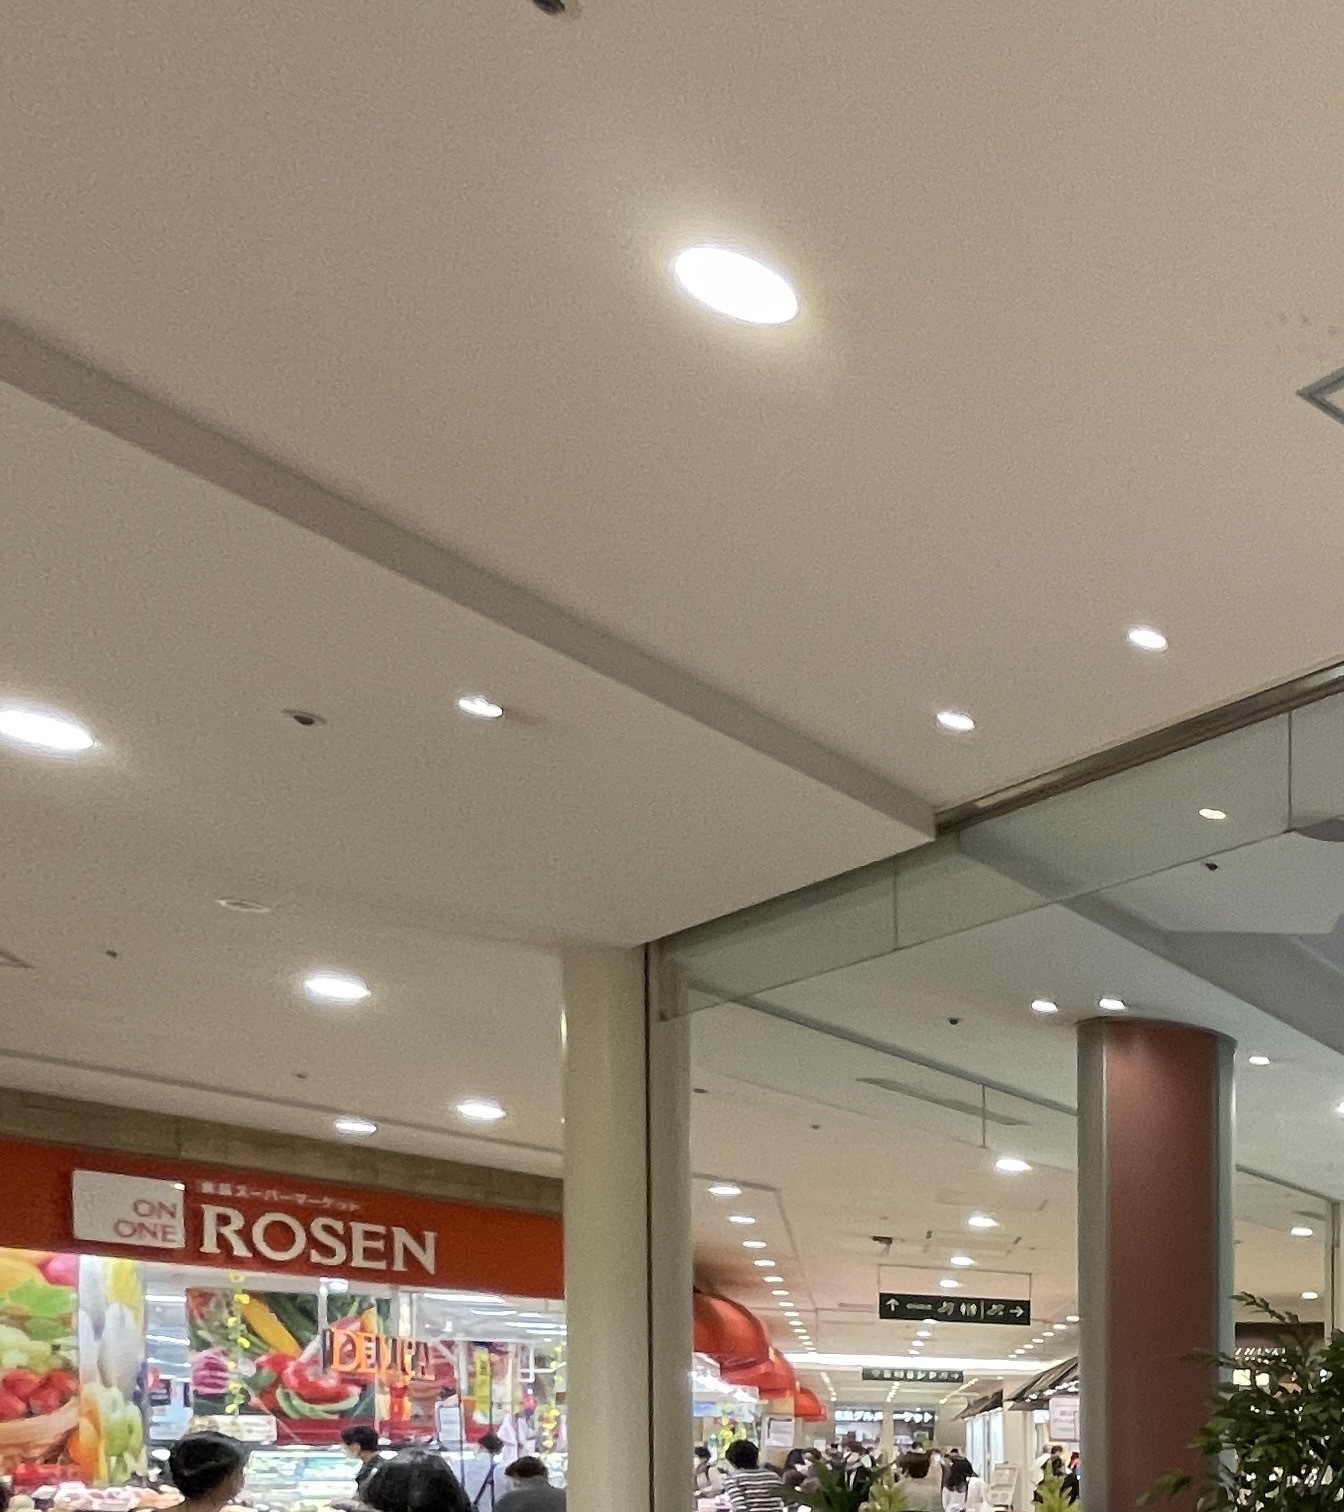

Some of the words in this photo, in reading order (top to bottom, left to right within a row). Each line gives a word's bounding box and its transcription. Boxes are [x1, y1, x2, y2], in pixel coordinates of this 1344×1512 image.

[132, 1198, 178, 1220] ON
[112, 1219, 178, 1244] ONE
[199, 1203, 438, 1275] ROSEN
